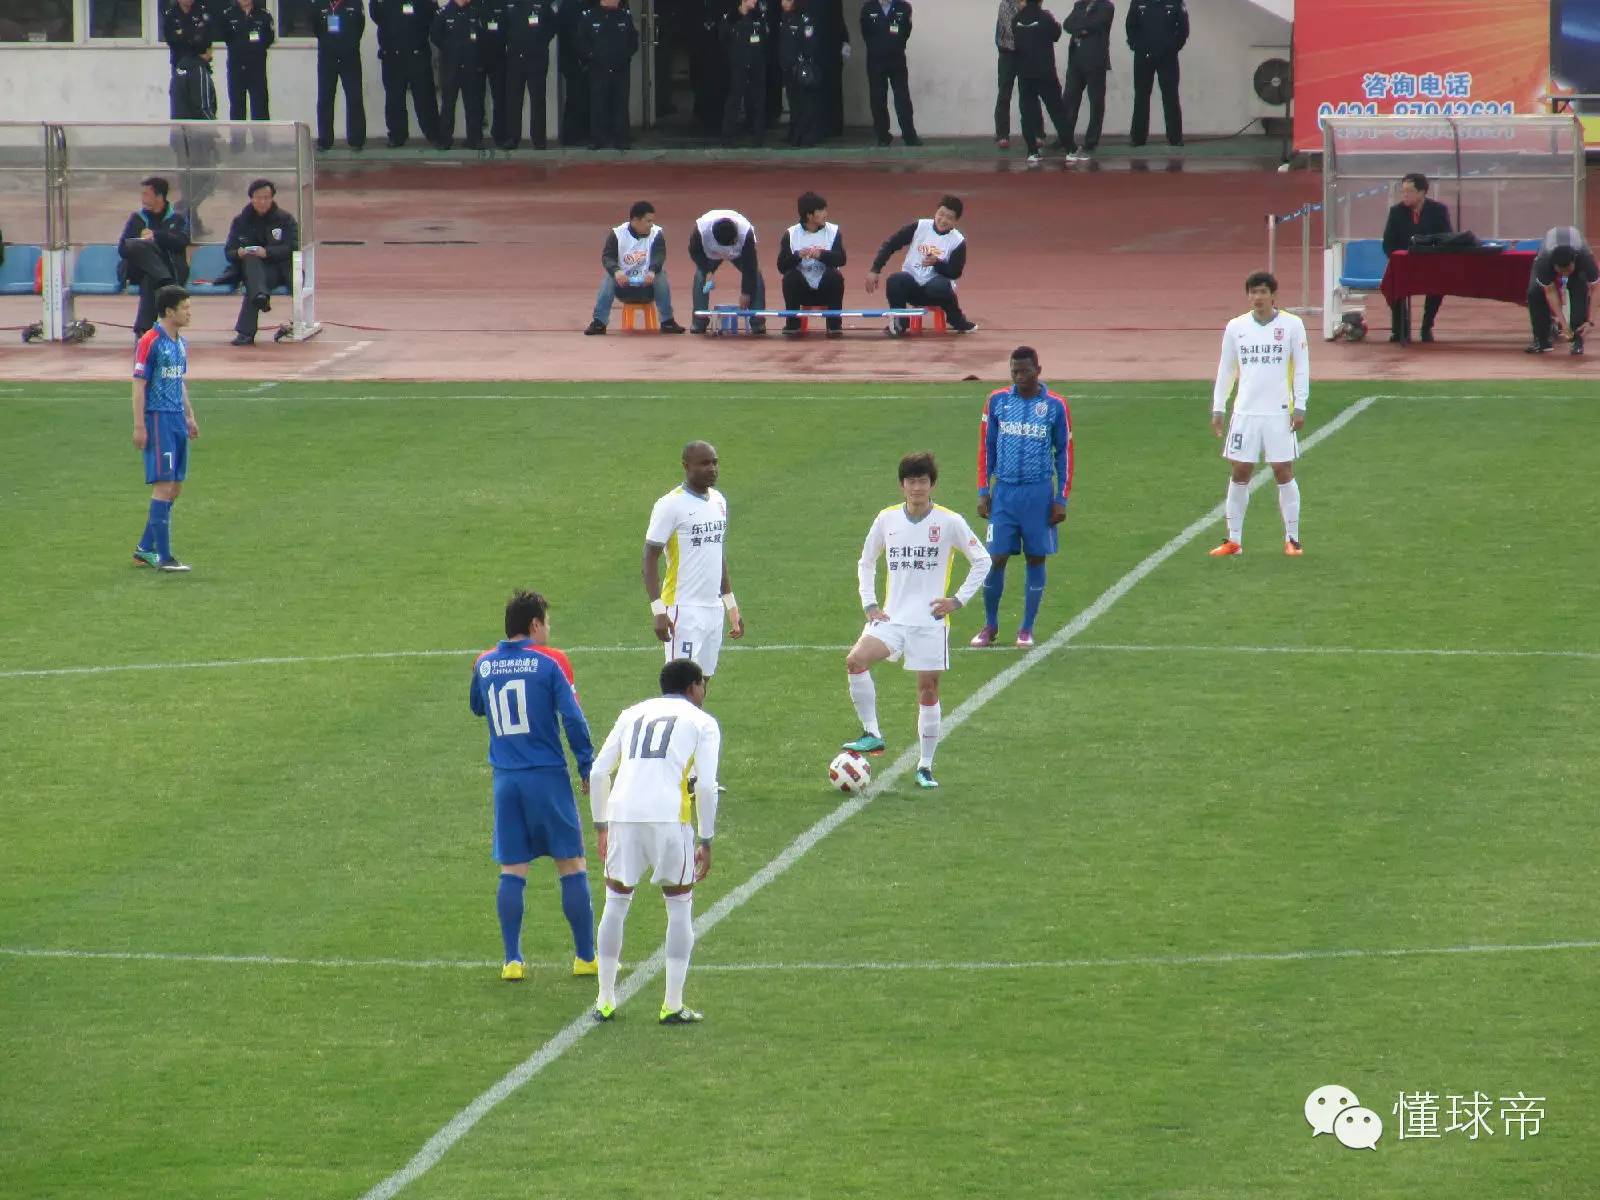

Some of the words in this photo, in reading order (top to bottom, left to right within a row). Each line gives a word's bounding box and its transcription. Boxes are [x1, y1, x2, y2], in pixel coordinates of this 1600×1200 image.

[1363, 73, 1471, 98] 咨询电话
[889, 546, 939, 558] 东北证券
[682, 641, 693, 660] 9
[491, 657, 539, 668] 中国移动通信
[491, 667, 512, 675] CHINA
[513, 665, 538, 673] MOBILE
[488, 679, 530, 737] 10
[629, 715, 678, 760] 10
